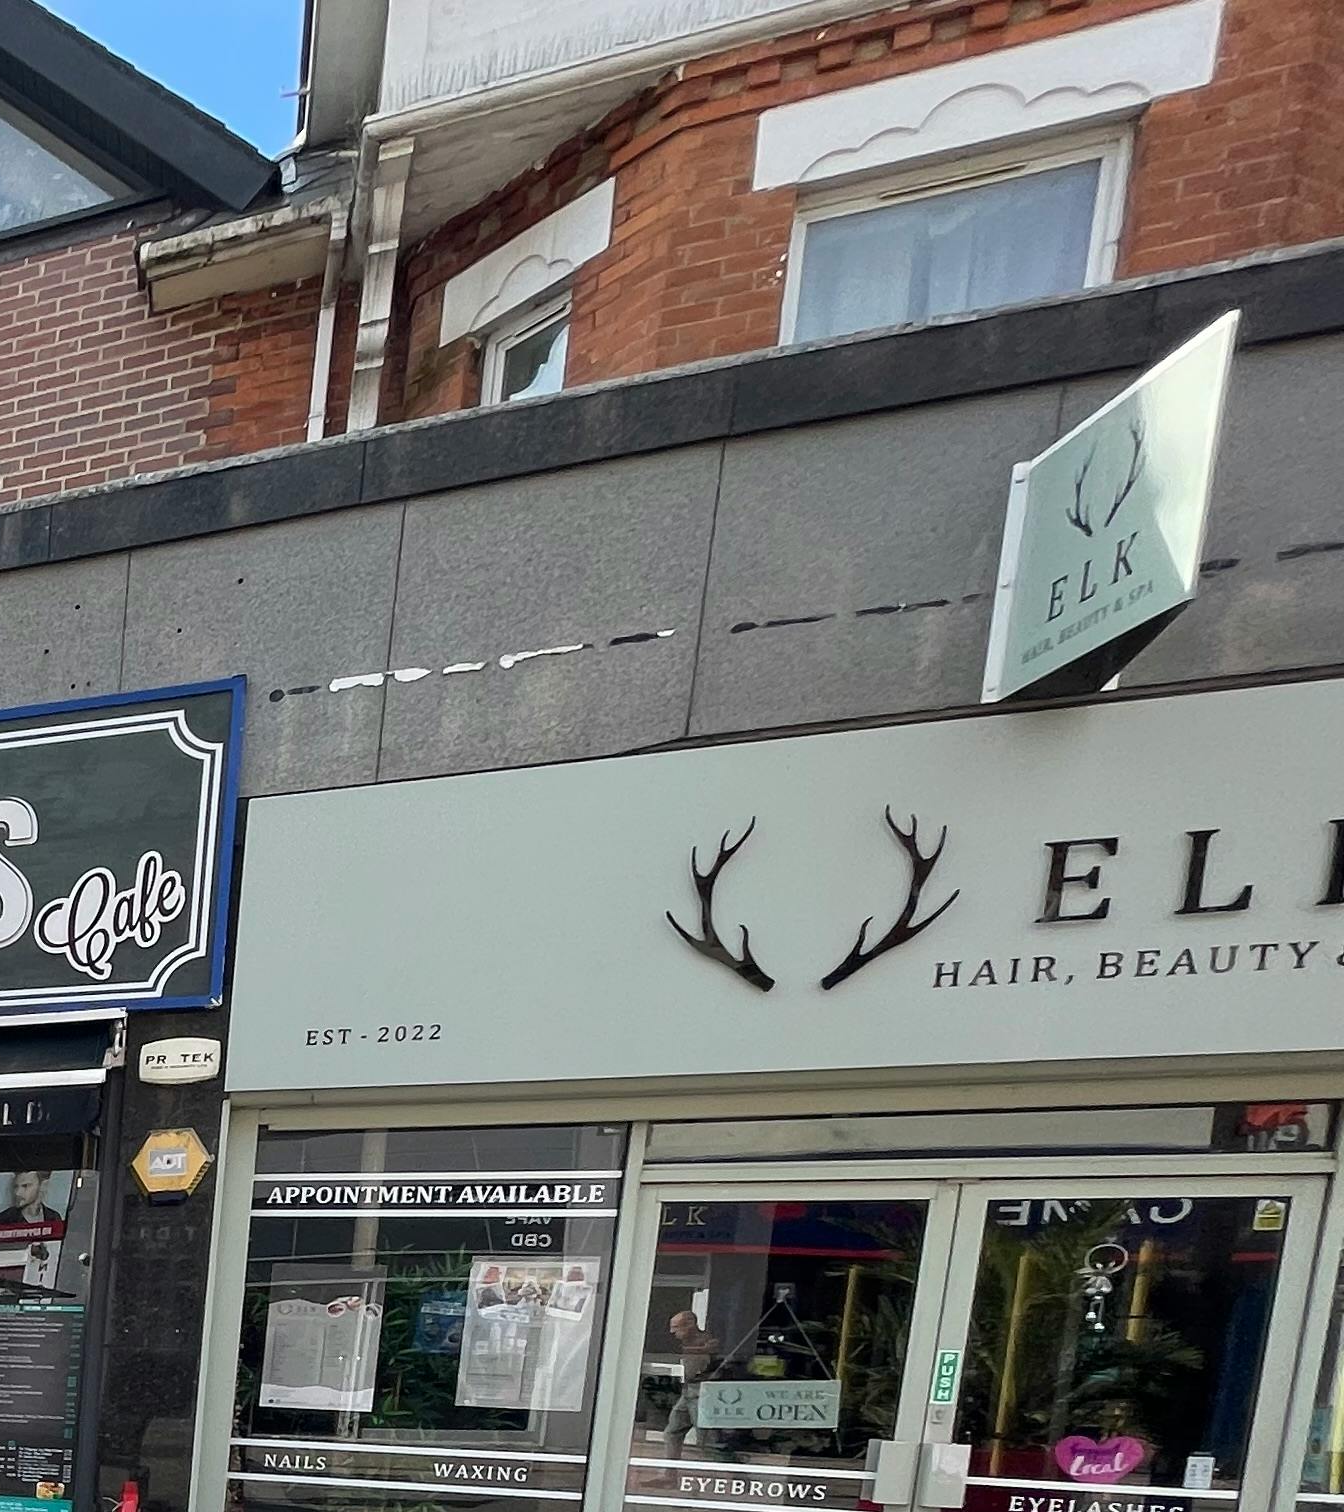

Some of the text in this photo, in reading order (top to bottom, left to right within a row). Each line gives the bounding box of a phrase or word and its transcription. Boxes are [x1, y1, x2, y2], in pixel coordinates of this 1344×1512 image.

[1045, 531, 1138, 622] ELK
[1033, 816, 1344, 923] EL
[36, 851, 186, 977] Cafe
[933, 955, 1075, 988] HAIR,
[1096, 941, 1320, 979] BEAUTY
[305, 1029, 351, 1046] EST
[377, 1024, 441, 1043] 2022
[150, 1153, 186, 1169] ADT
[266, 1184, 605, 1204] APPOINTMENT AVAILABLE
[937, 1353, 955, 1401] PUSH
[756, 1404, 826, 1421] OPEN
[264, 1453, 326, 1471] NAILS
[433, 1462, 529, 1484] WAXING
[679, 1476, 828, 1501] EYEBROWS
